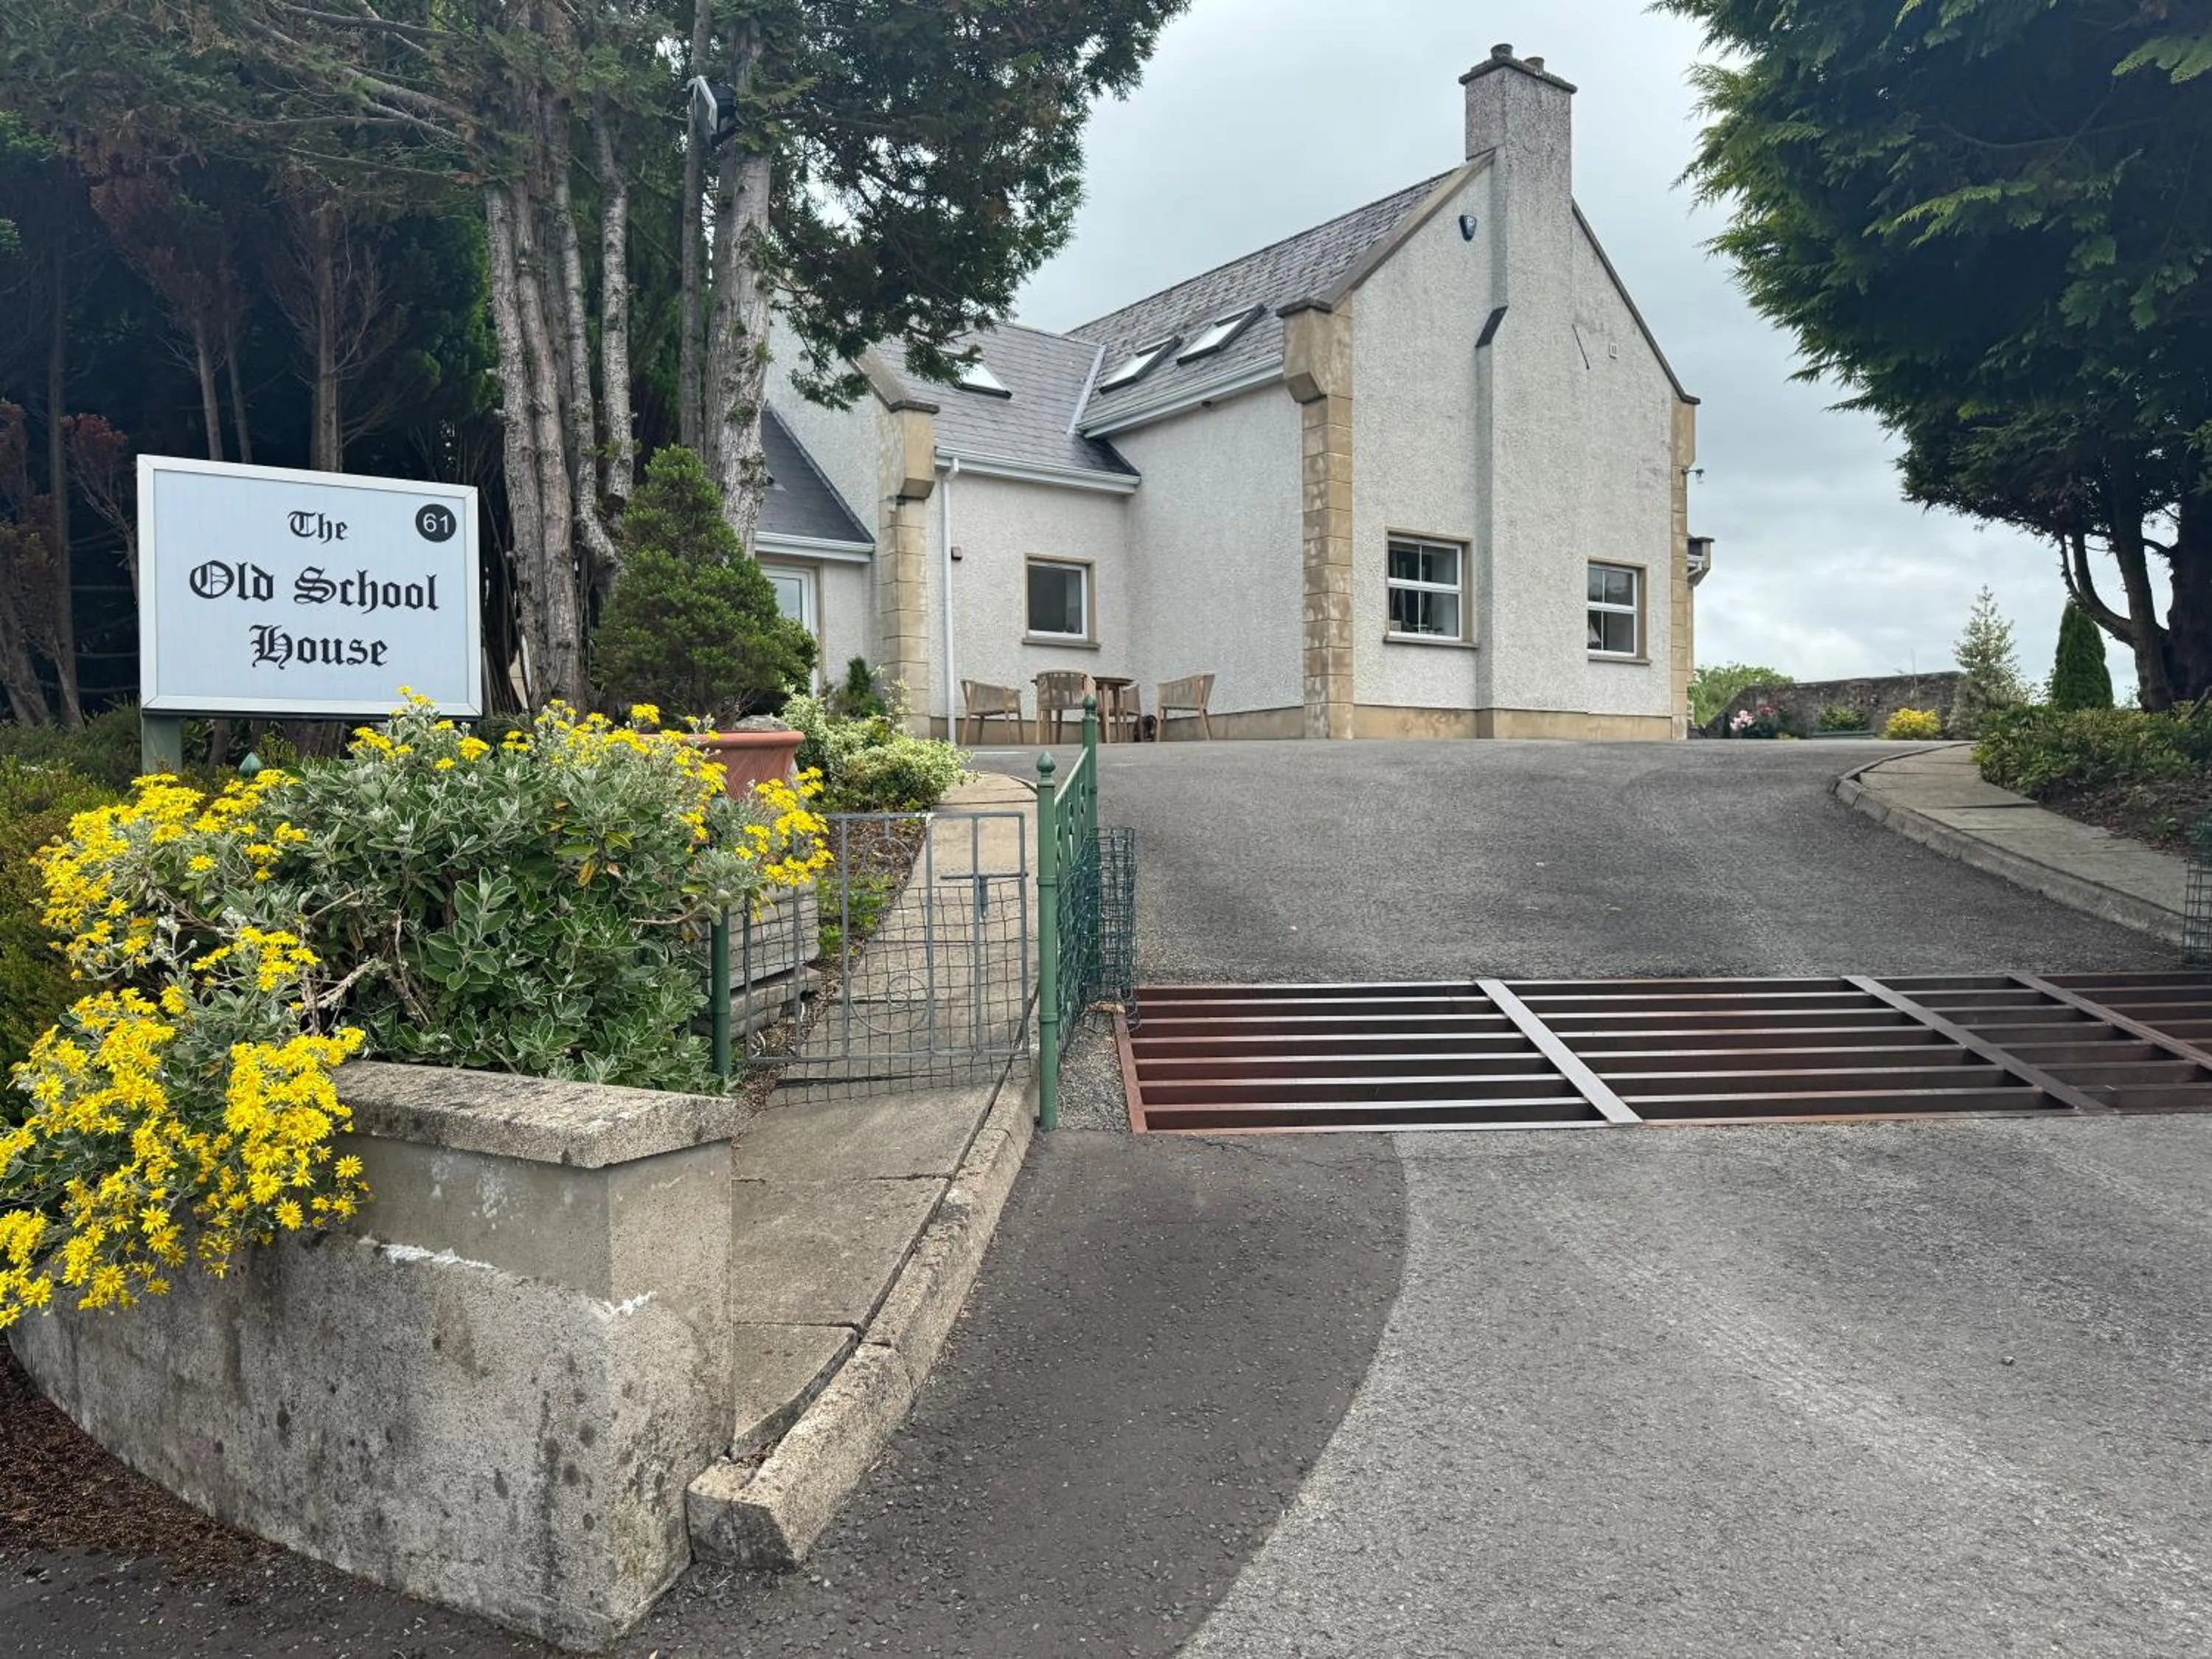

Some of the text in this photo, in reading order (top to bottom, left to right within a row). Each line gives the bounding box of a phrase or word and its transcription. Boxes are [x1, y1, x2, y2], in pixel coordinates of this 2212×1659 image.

[288, 510, 348, 543] The
[422, 512, 451, 533] 61
[189, 560, 439, 614] Old School
[249, 625, 388, 669] House
